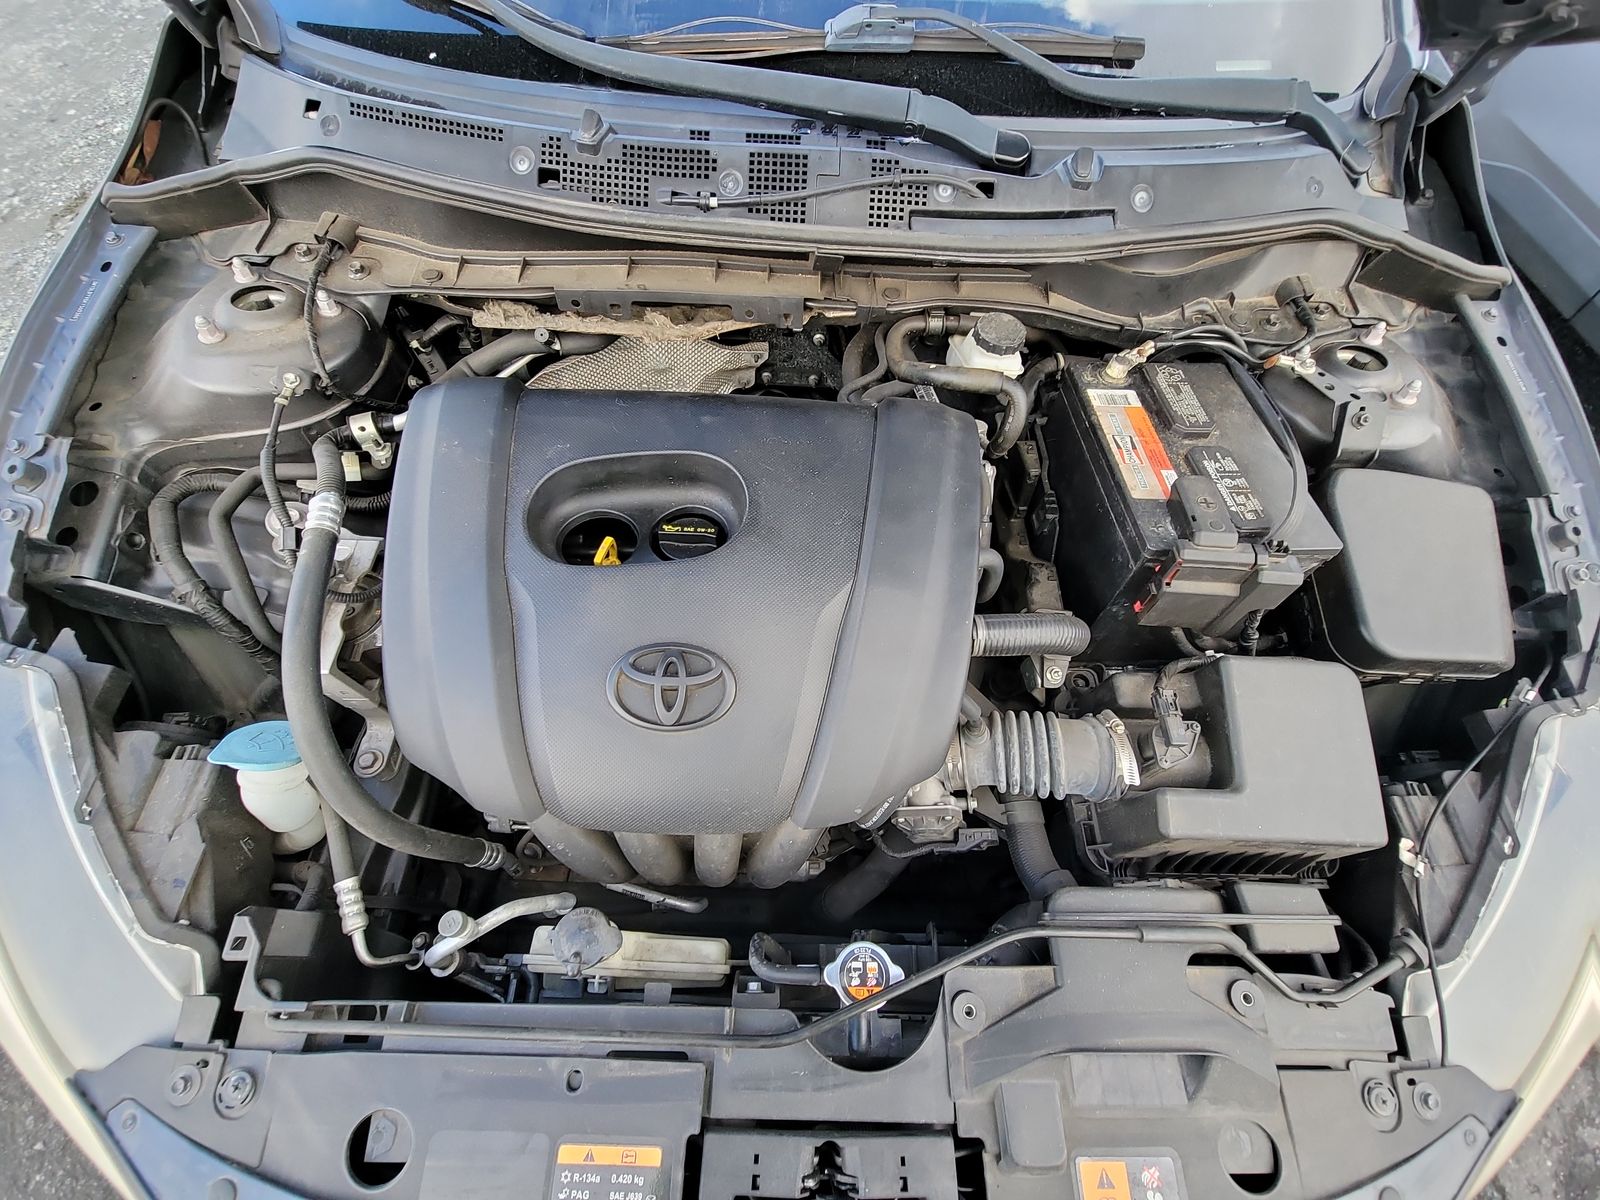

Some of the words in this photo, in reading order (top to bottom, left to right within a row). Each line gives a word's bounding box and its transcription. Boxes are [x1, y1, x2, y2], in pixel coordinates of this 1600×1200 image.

[1120, 436, 1137, 464] CHAMPION
[1202, 460, 1218, 479] POISON
[1216, 483, 1234, 507] DANGER
[573, 1173, 601, 1183] R-134a
[611, 1174, 633, 1184] 0.420
[633, 1174, 644, 1186] kg
[570, 1190, 590, 1200] PAG
[609, 1191, 625, 1200] SAE
